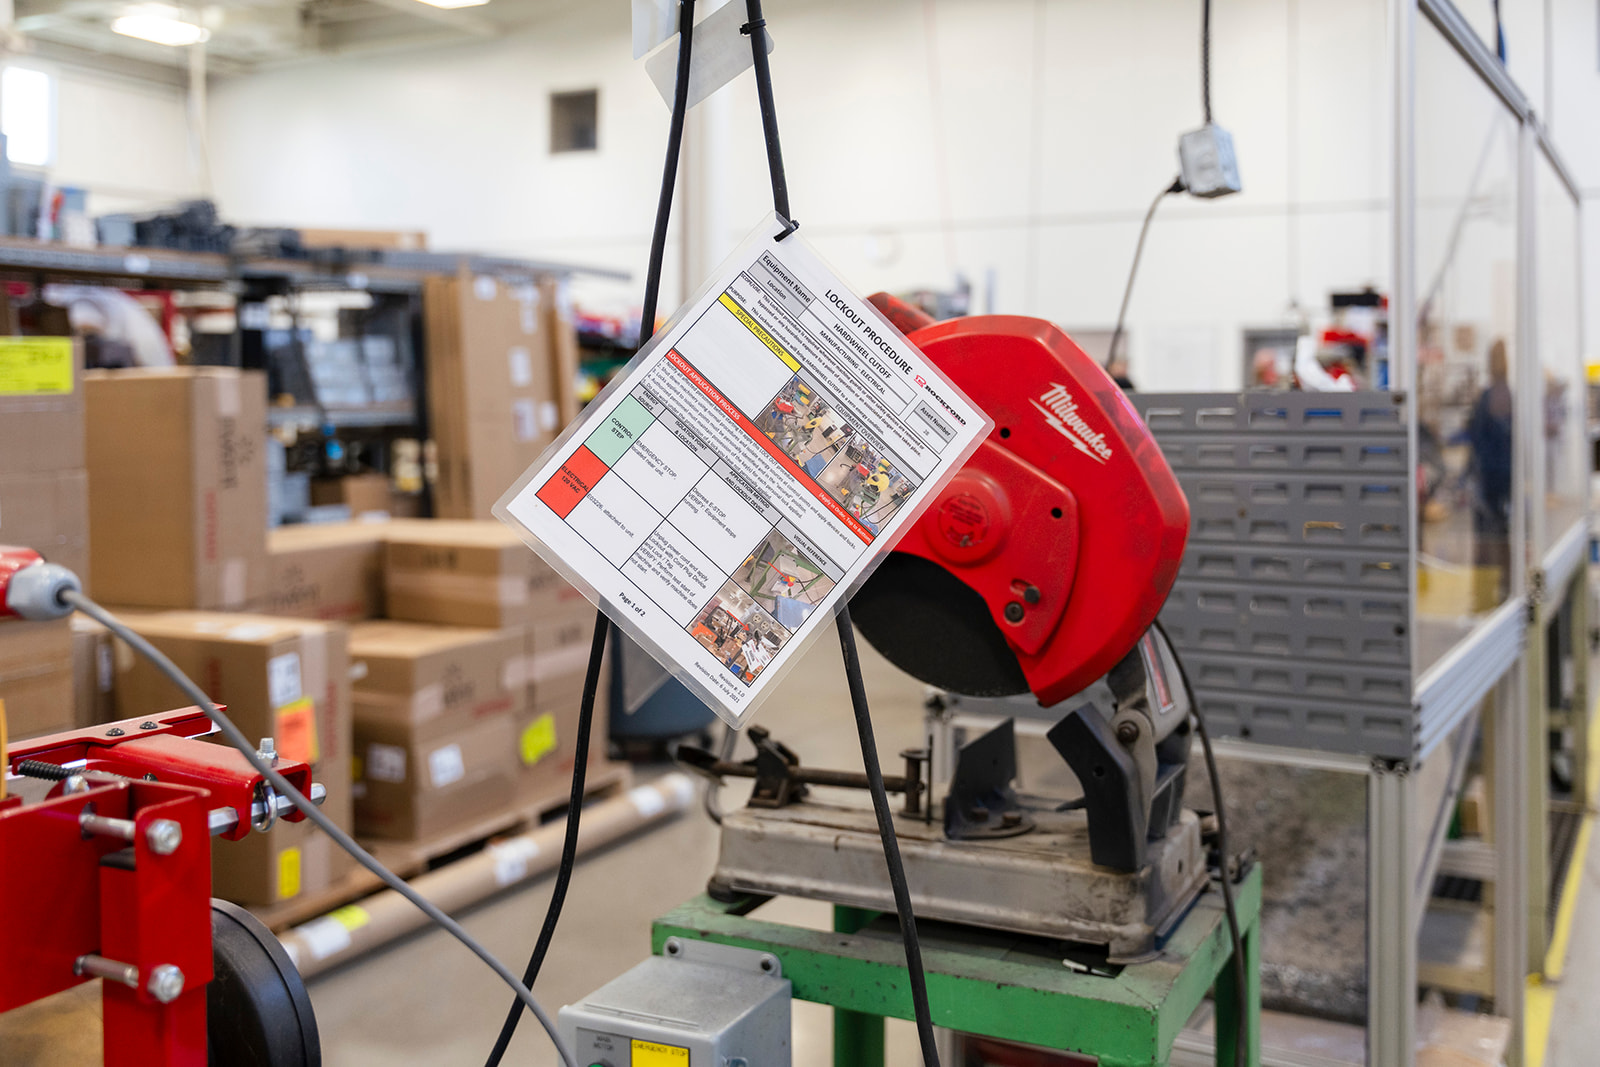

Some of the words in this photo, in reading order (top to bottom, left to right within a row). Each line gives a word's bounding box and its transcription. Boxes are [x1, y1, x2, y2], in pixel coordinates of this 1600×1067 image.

[728, 285, 746, 304] PURPOSE:
[762, 254, 794, 286] Equipment
[792, 283, 810, 303] Name
[766, 279, 786, 300] Location
[734, 308, 754, 328] SPECIAL
[752, 324, 784, 356] PRECAUTIONS
[824, 288, 866, 328] LOCKOUT
[862, 325, 913, 375] PROCEDURE
[832, 322, 869, 359] HARDWHEEL
[868, 356, 892, 378] CUTOFF
[750, 306, 759, 316] This
[757, 313, 773, 329] Lockout
[770, 327, 790, 345] procedure
[789, 344, 798, 352] will
[795, 349, 806, 361] bring
[804, 358, 828, 381] HARDWHEEL
[826, 379, 842, 394] CUTOFF
[846, 399, 856, 408] zero
[854, 406, 868, 419] energy
[756, 299, 775, 317] bypassed
[777, 319, 785, 327] any
[784, 325, 803, 344] hazardous
[801, 342, 818, 359] exposure
[823, 364, 835, 374] point
[837, 376, 855, 394] operation
[863, 401, 883, 419] associated
[880, 417, 894, 430] danger
[892, 429, 902, 438] zone
[900, 436, 911, 447] takes
[762, 294, 770, 303] This
[768, 301, 784, 317] Lockout
[782, 314, 801, 333] procedure
[803, 334, 820, 350] required
[818, 349, 836, 366] whenever
[834, 364, 851, 380] machine
[848, 378, 862, 391] guards
[865, 393, 876, 404] other
[874, 402, 886, 414] safety
[885, 412, 899, 426] devices
[903, 430, 921, 446] removed
[818, 329, 859, 369] MANUFACTURING
[859, 368, 885, 395] ELECTRICAL
[637, 395, 653, 411] SOURCE
[642, 390, 658, 405] ENERGY
[667, 350, 691, 373] LOCKOUT
[688, 371, 721, 401] APPLICATION
[718, 398, 740, 420] PROCESS
[919, 406, 934, 420] Asset
[931, 417, 950, 436] Number
[924, 384, 966, 425] ROCKFORD
[1040, 382, 1112, 460] Milwaukee
[610, 417, 633, 439] CONTROL
[610, 426, 624, 438] STEP
[674, 420, 696, 440] ISOLATION
[693, 437, 707, 450] POINT
[677, 432, 698, 452] LOCATION
[834, 402, 862, 430] EQUIPMENT
[860, 427, 885, 451] OVERVIEW
[630, 445, 647, 460] located
[644, 458, 656, 468] near
[654, 467, 664, 476] unit.
[635, 439, 664, 466] EMERGENCY
[662, 464, 677, 480] STOP,
[560, 465, 589, 492] ELECTRICAL
[561, 475, 570, 484] 120
[569, 481, 580, 493] VAC
[724, 476, 735, 486] AND
[732, 483, 752, 501] LOCKOUT
[749, 499, 764, 513] DEVICE
[728, 470, 754, 494] APPLICATION
[752, 491, 770, 508] METHOD
[682, 497, 699, 514] running.
[687, 492, 705, 508] VERIFY:
[703, 507, 726, 528] Equipment
[724, 526, 736, 538] stops
[691, 486, 709, 504] Depress
[707, 501, 726, 518] E-STOP.
[818, 492, 831, 505] (Apply
[834, 506, 846, 520] Order,
[845, 516, 853, 526] Top
[856, 527, 873, 543] Bottom)
[602, 508, 622, 526] attached
[624, 528, 634, 538] unit.
[629, 556, 638, 565] not
[636, 562, 647, 573] start.
[643, 541, 654, 550] and
[651, 547, 662, 559] Lock
[664, 558, 674, 569] Tag.
[648, 535, 666, 552] Lockout
[664, 550, 674, 559] with
[672, 556, 684, 568] Cord
[682, 565, 693, 577] Plug
[691, 574, 706, 589] Device
[653, 529, 669, 546] Unplug
[666, 543, 681, 556] power
[679, 554, 690, 565] cord
[688, 562, 698, 572] and
[696, 569, 708, 582] apply
[793, 533, 807, 548] VISUAL
[805, 545, 827, 566] REFERENCE
[634, 551, 652, 568] machine
[650, 566, 661, 576] and
[659, 573, 671, 586] verify
[669, 583, 688, 600] machine
[686, 598, 698, 610] does
[639, 545, 657, 562] VERIFY:
[656, 560, 673, 578] Perform
[671, 575, 682, 585] test
[679, 582, 690, 593] start
[618, 591, 632, 605] Page
[694, 661, 710, 677] Revision
[708, 674, 719, 684] Date:
[721, 686, 730, 695] July
[728, 692, 740, 703] 2021
[718, 672, 734, 688] Revision
[632, 1043, 668, 1054] EMERGENCY
[671, 1048, 687, 1056] STOP
